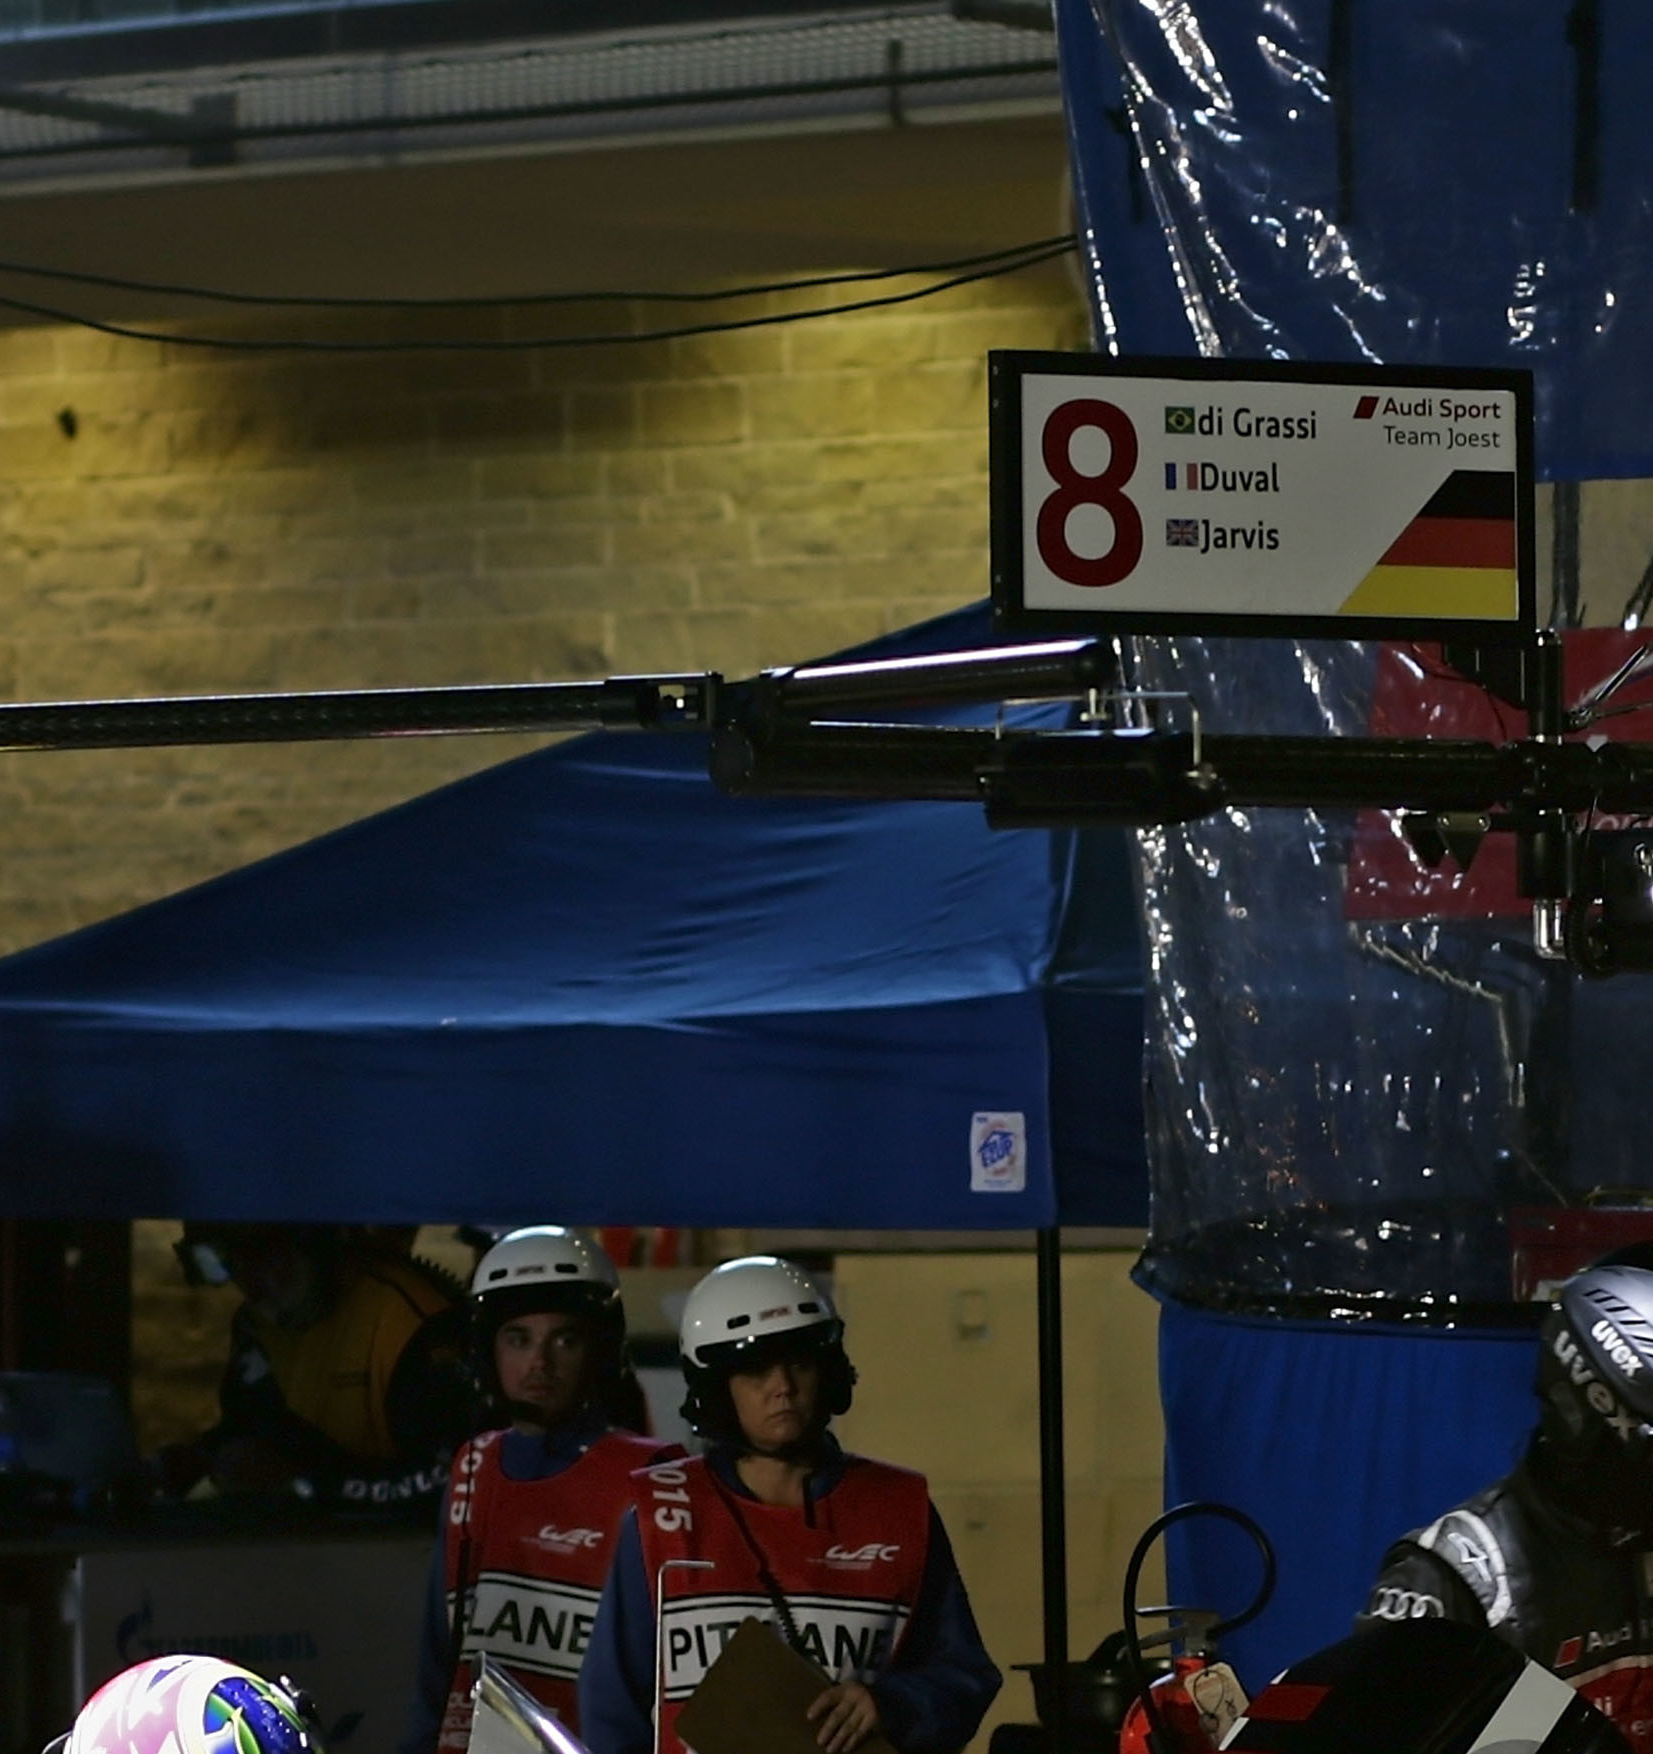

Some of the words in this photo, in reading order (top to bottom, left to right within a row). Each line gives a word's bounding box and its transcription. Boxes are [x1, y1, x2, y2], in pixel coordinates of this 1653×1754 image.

[1197, 407, 1224, 436] di
[1233, 408, 1317, 439] Grassi
[1382, 397, 1435, 418] Audi
[1439, 398, 1501, 422] Sport
[1383, 424, 1441, 447] Team
[1446, 426, 1500, 449] Joest
[1036, 398, 1143, 587] 8
[1200, 461, 1280, 493] Duval
[1200, 518, 1280, 552] Jarvis
[1591, 1319, 1645, 1378] uvex
[1553, 1329, 1638, 1442] uvex
[825, 1542, 901, 1563] WEC
[669, 1621, 742, 1672] PIT
[796, 1620, 892, 1671] ANE
